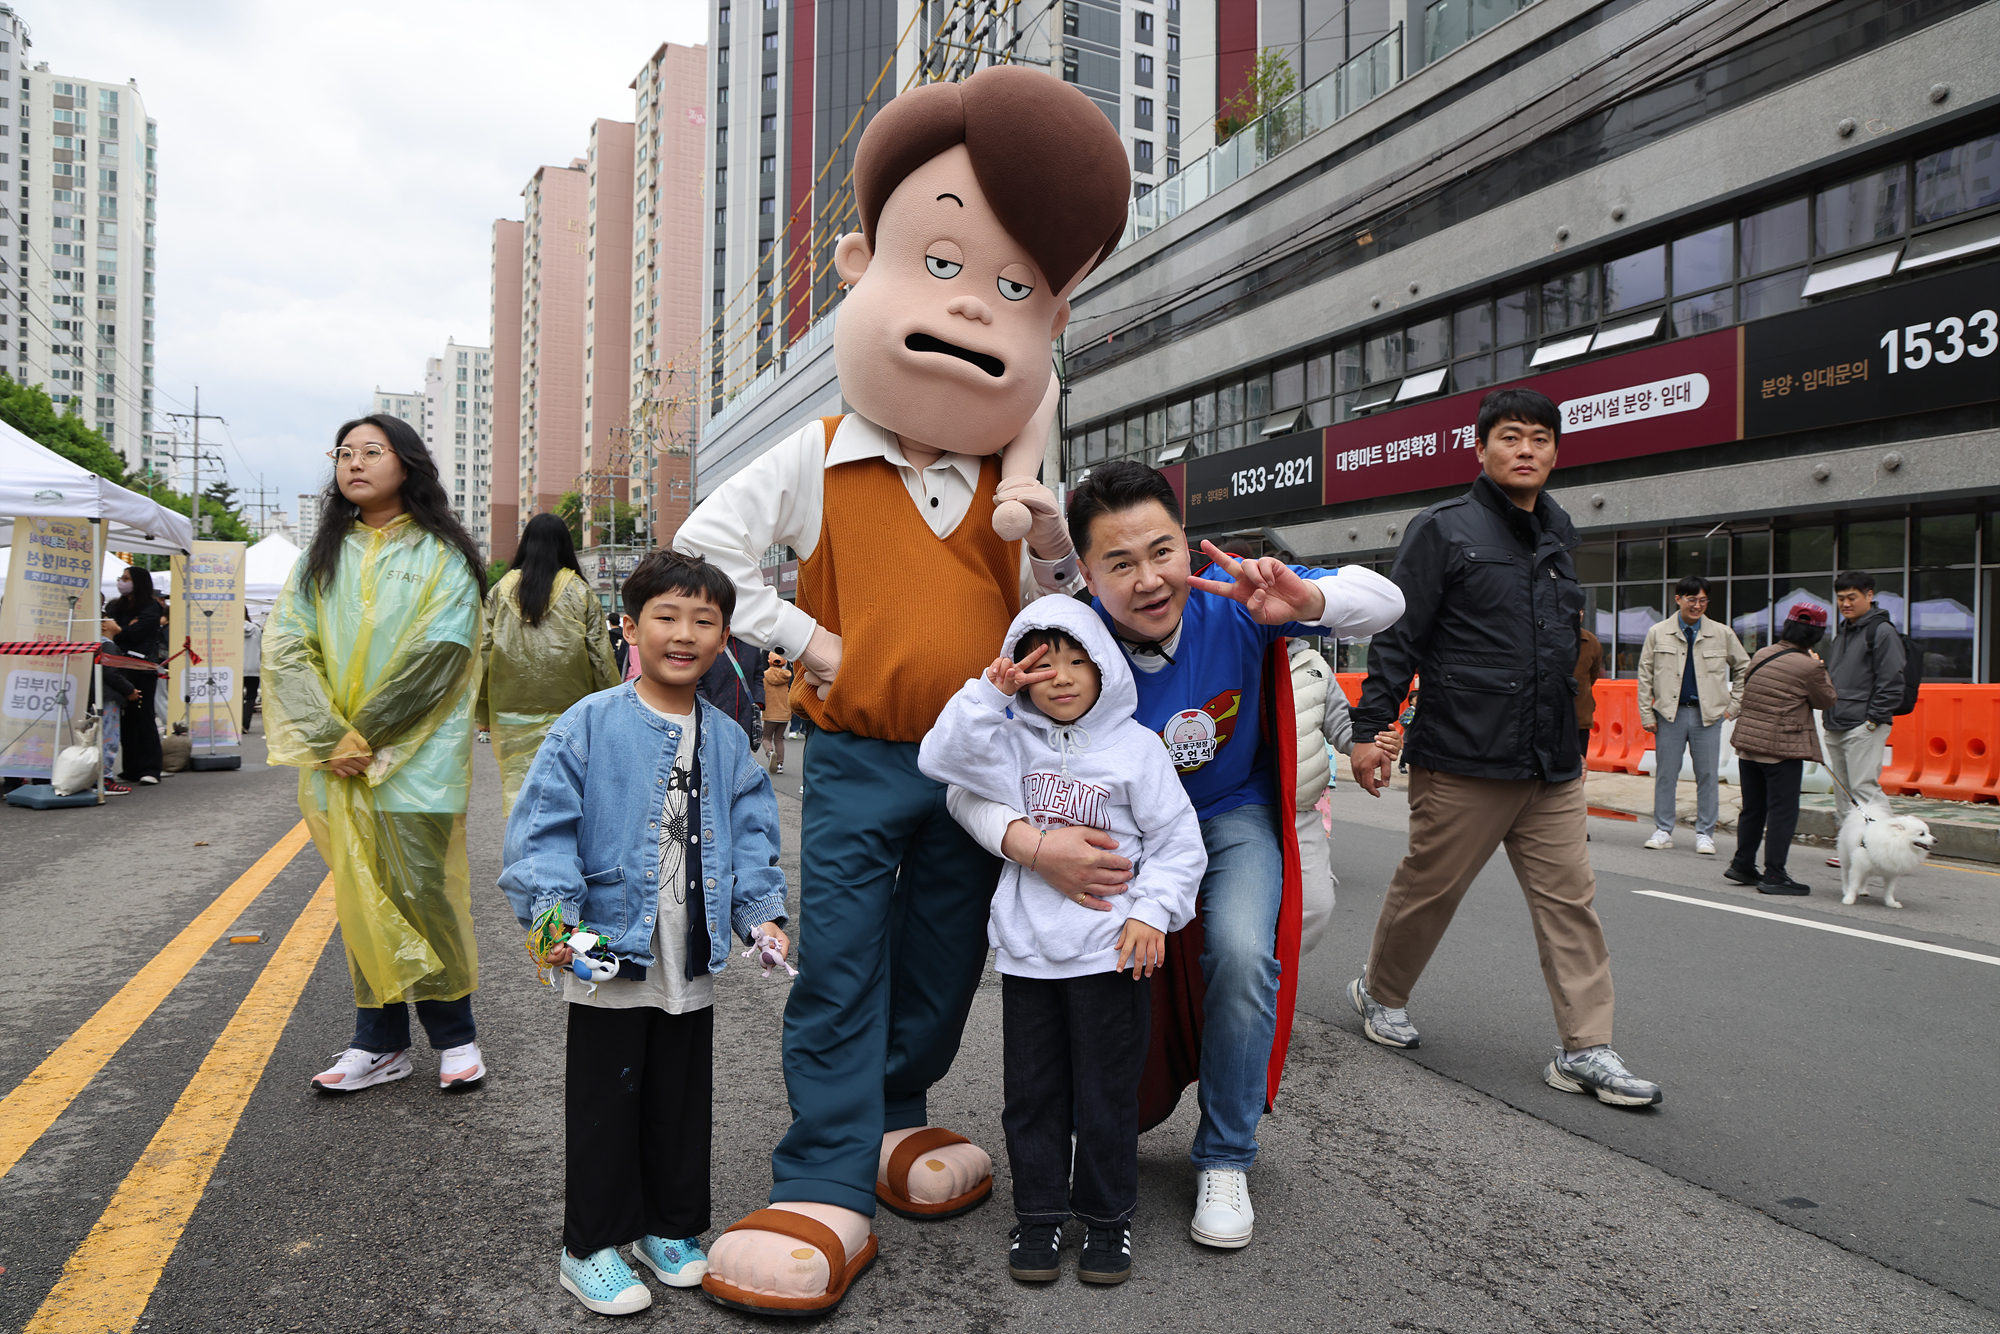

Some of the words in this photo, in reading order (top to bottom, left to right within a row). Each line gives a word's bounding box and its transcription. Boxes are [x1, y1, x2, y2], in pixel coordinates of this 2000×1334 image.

[1879, 309, 1999, 375] 1533
[1567, 396, 1620, 426] 상업시설
[1336, 445, 1384, 472] 대형마트
[1385, 432, 1438, 464] 입점확정
[1451, 423, 1476, 450] 7월
[1231, 455, 1313, 497] 1533-2821
[1176, 740, 1208, 751] 도봉구청장
